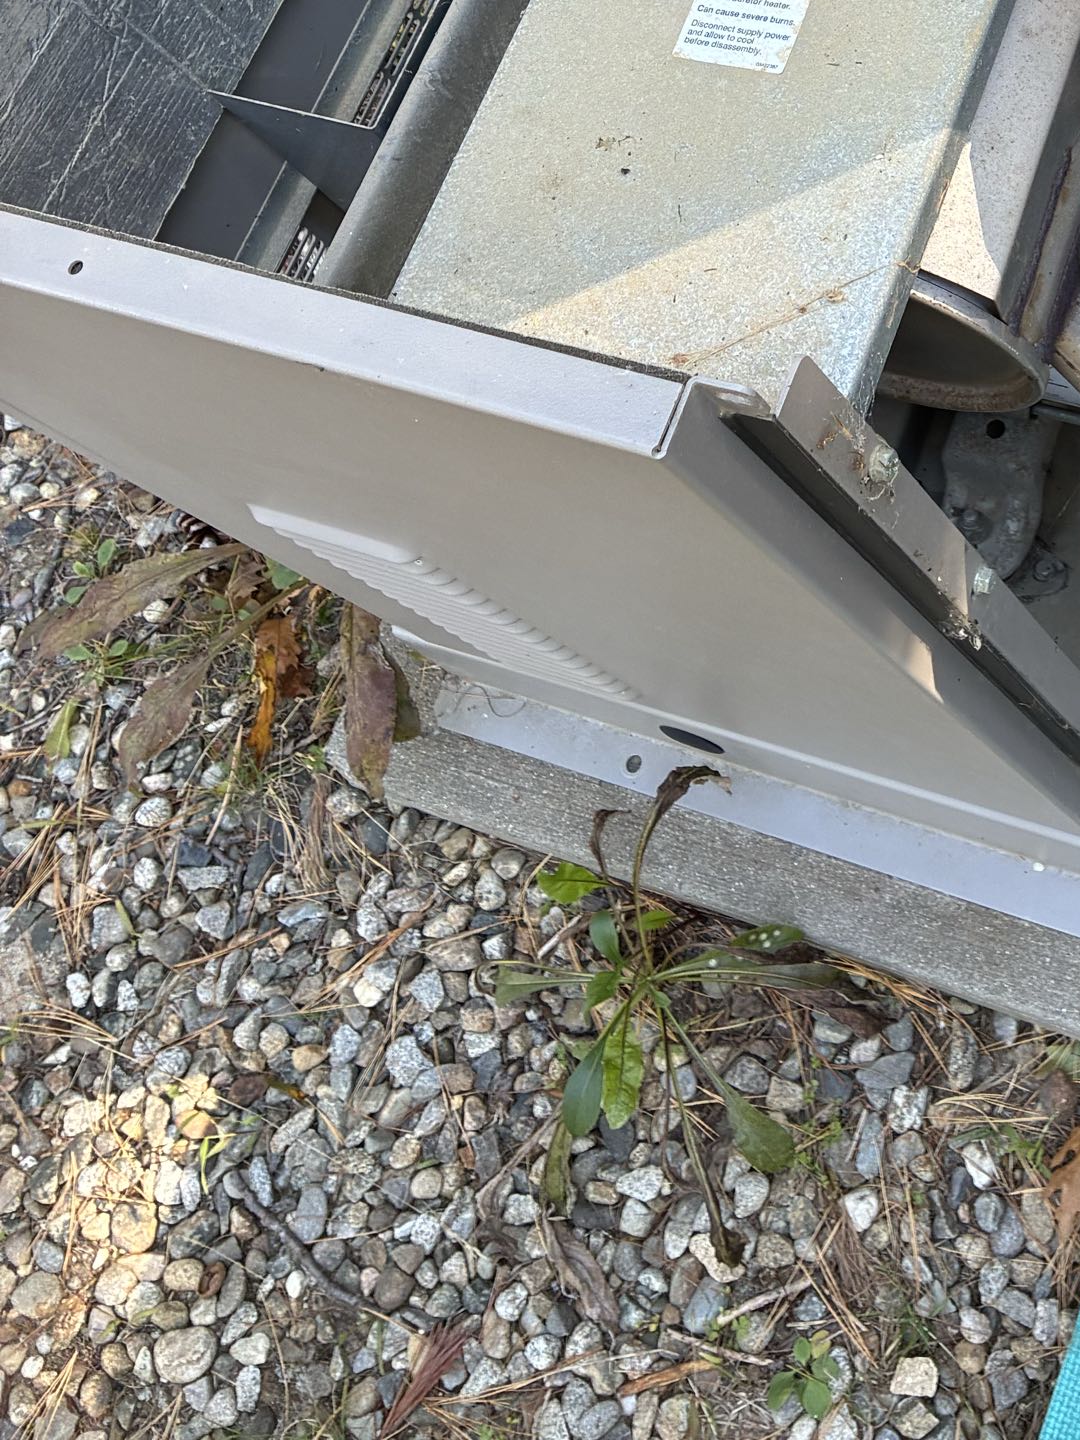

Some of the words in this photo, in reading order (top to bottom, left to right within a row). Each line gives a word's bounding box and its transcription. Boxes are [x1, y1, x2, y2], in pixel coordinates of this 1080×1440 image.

[696, 4, 715, 14] Can
[715, 8, 740, 18] cause
[741, 12, 769, 22] severe
[769, 16, 795, 26] burns.
[763, 0, 792, 10] heater.
[687, 27, 704, 37] and
[703, 30, 726, 41] allow
[726, 33, 737, 42] to
[736, 35, 755, 45] cool
[690, 18, 736, 34] Disconnect
[736, 27, 764, 39] supply
[764, 31, 791, 43] power
[683, 35, 711, 47] before
[710, 39, 764, 58] disassembly.
